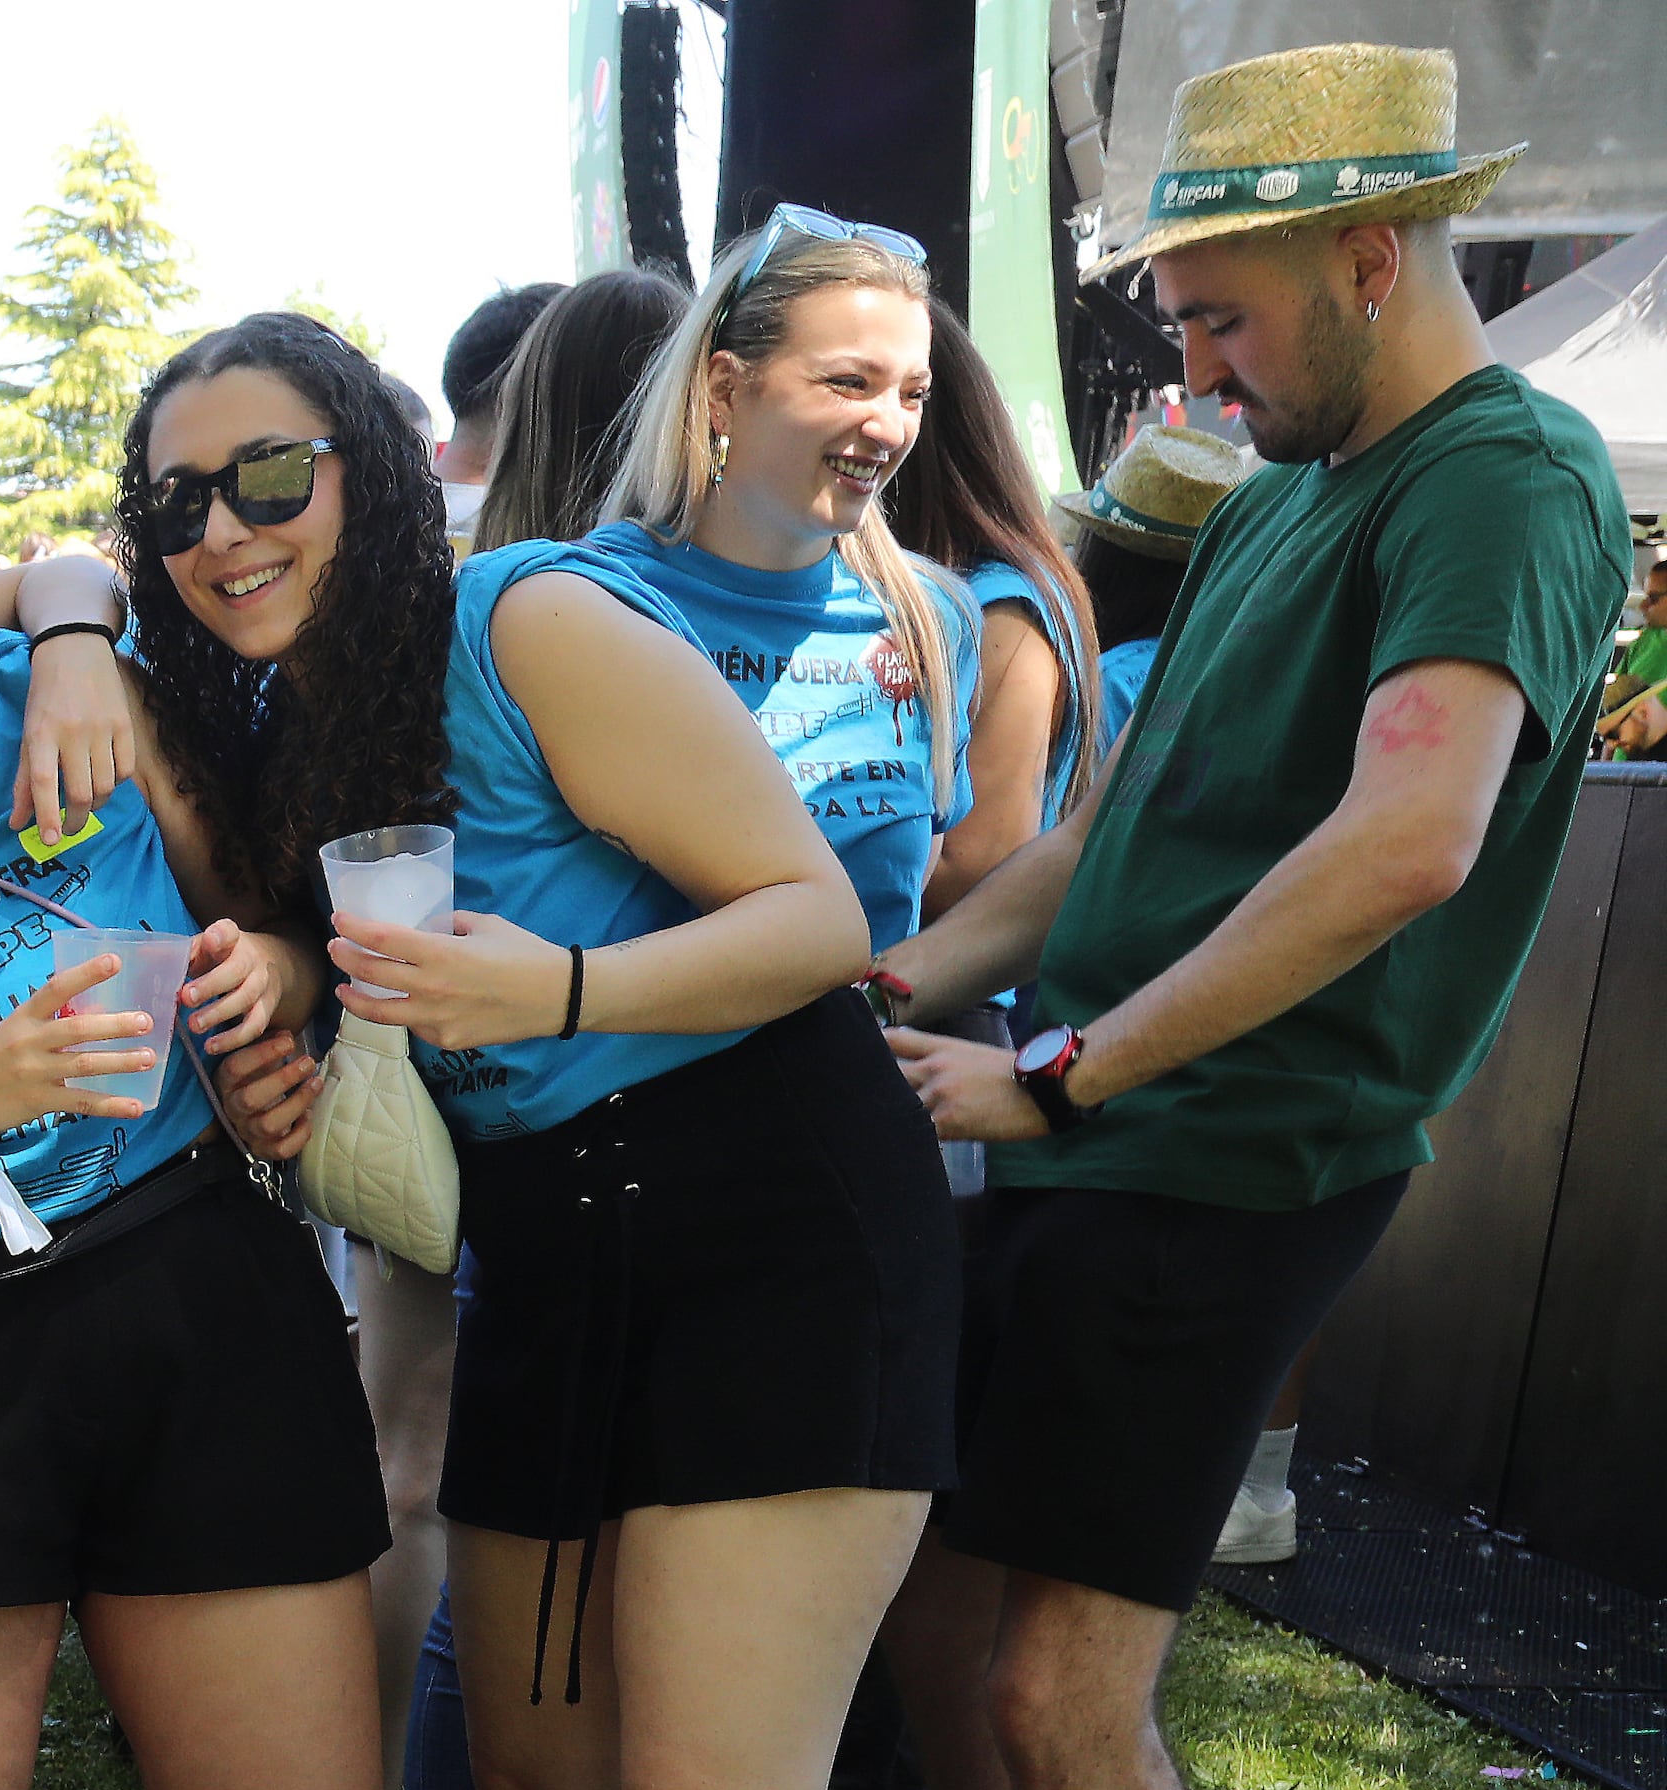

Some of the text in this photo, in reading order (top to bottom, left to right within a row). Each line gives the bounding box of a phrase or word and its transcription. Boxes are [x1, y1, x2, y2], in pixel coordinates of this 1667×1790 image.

[712, 645, 865, 687] IÉN FUERA
[876, 651, 908, 669] PLAT
[884, 666, 913, 686] PLOM
[867, 760, 907, 782] EN
[855, 795, 899, 816] LA
